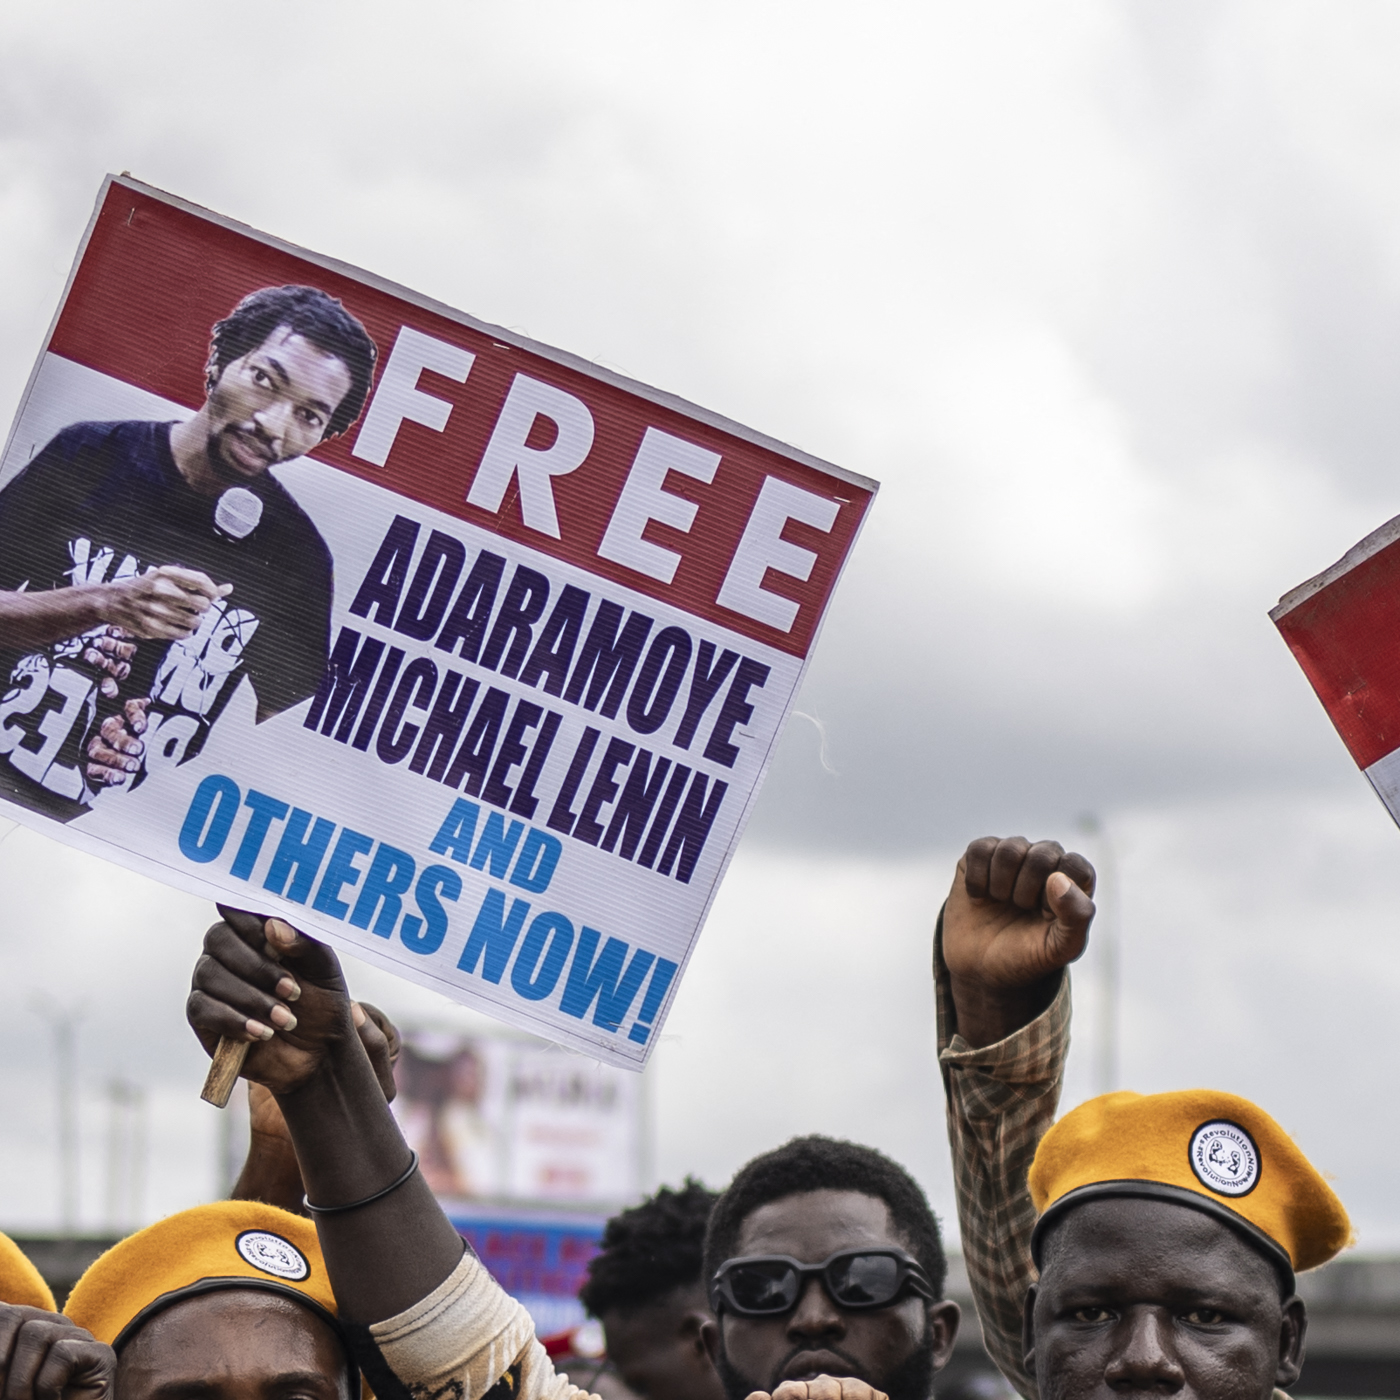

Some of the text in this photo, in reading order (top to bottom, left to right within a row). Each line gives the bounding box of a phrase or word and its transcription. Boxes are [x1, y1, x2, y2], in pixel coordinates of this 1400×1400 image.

[351, 326, 840, 633] FREE
[303, 626, 563, 820] MICHAEL
[546, 725, 729, 884] LENIN
[349, 512, 771, 768] ADARAMOYE
[179, 773, 680, 1044] OTHERS NOW!
[429, 797, 563, 894] AND
